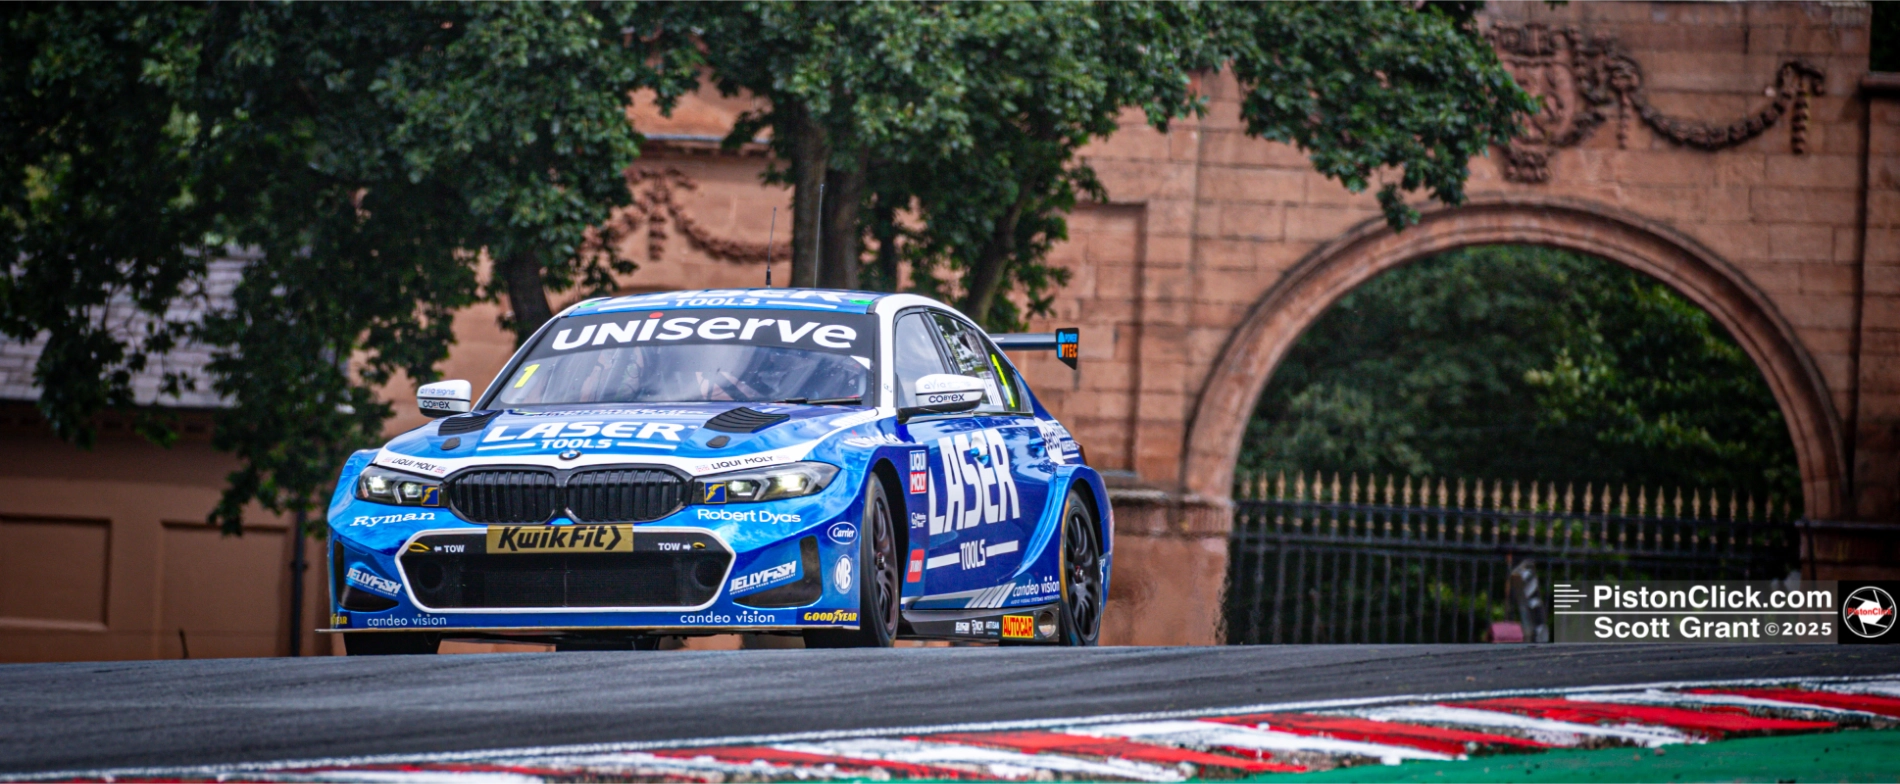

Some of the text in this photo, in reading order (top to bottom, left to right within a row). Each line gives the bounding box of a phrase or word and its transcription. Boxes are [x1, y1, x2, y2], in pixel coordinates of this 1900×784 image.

[675, 297, 760, 307] TOOLS
[513, 363, 540, 388] 1
[482, 421, 686, 442] LASER
[541, 438, 613, 449] TOOLS
[391, 457, 437, 472] LIQUI MOLY
[711, 454, 774, 470] LIQUI MOLY
[929, 428, 1020, 536] LASER
[349, 511, 436, 527] Ryman
[697, 508, 801, 525] Robert Dyas
[832, 526, 855, 538] Carrier
[443, 544, 465, 553] TOW
[658, 542, 681, 551] TOW
[960, 539, 986, 570] TOOLS
[1012, 575, 1060, 597] candeo vision
[367, 613, 447, 627] candeo vision
[680, 610, 776, 624] candeo vision
[1003, 616, 1033, 637] AUTOCAR
